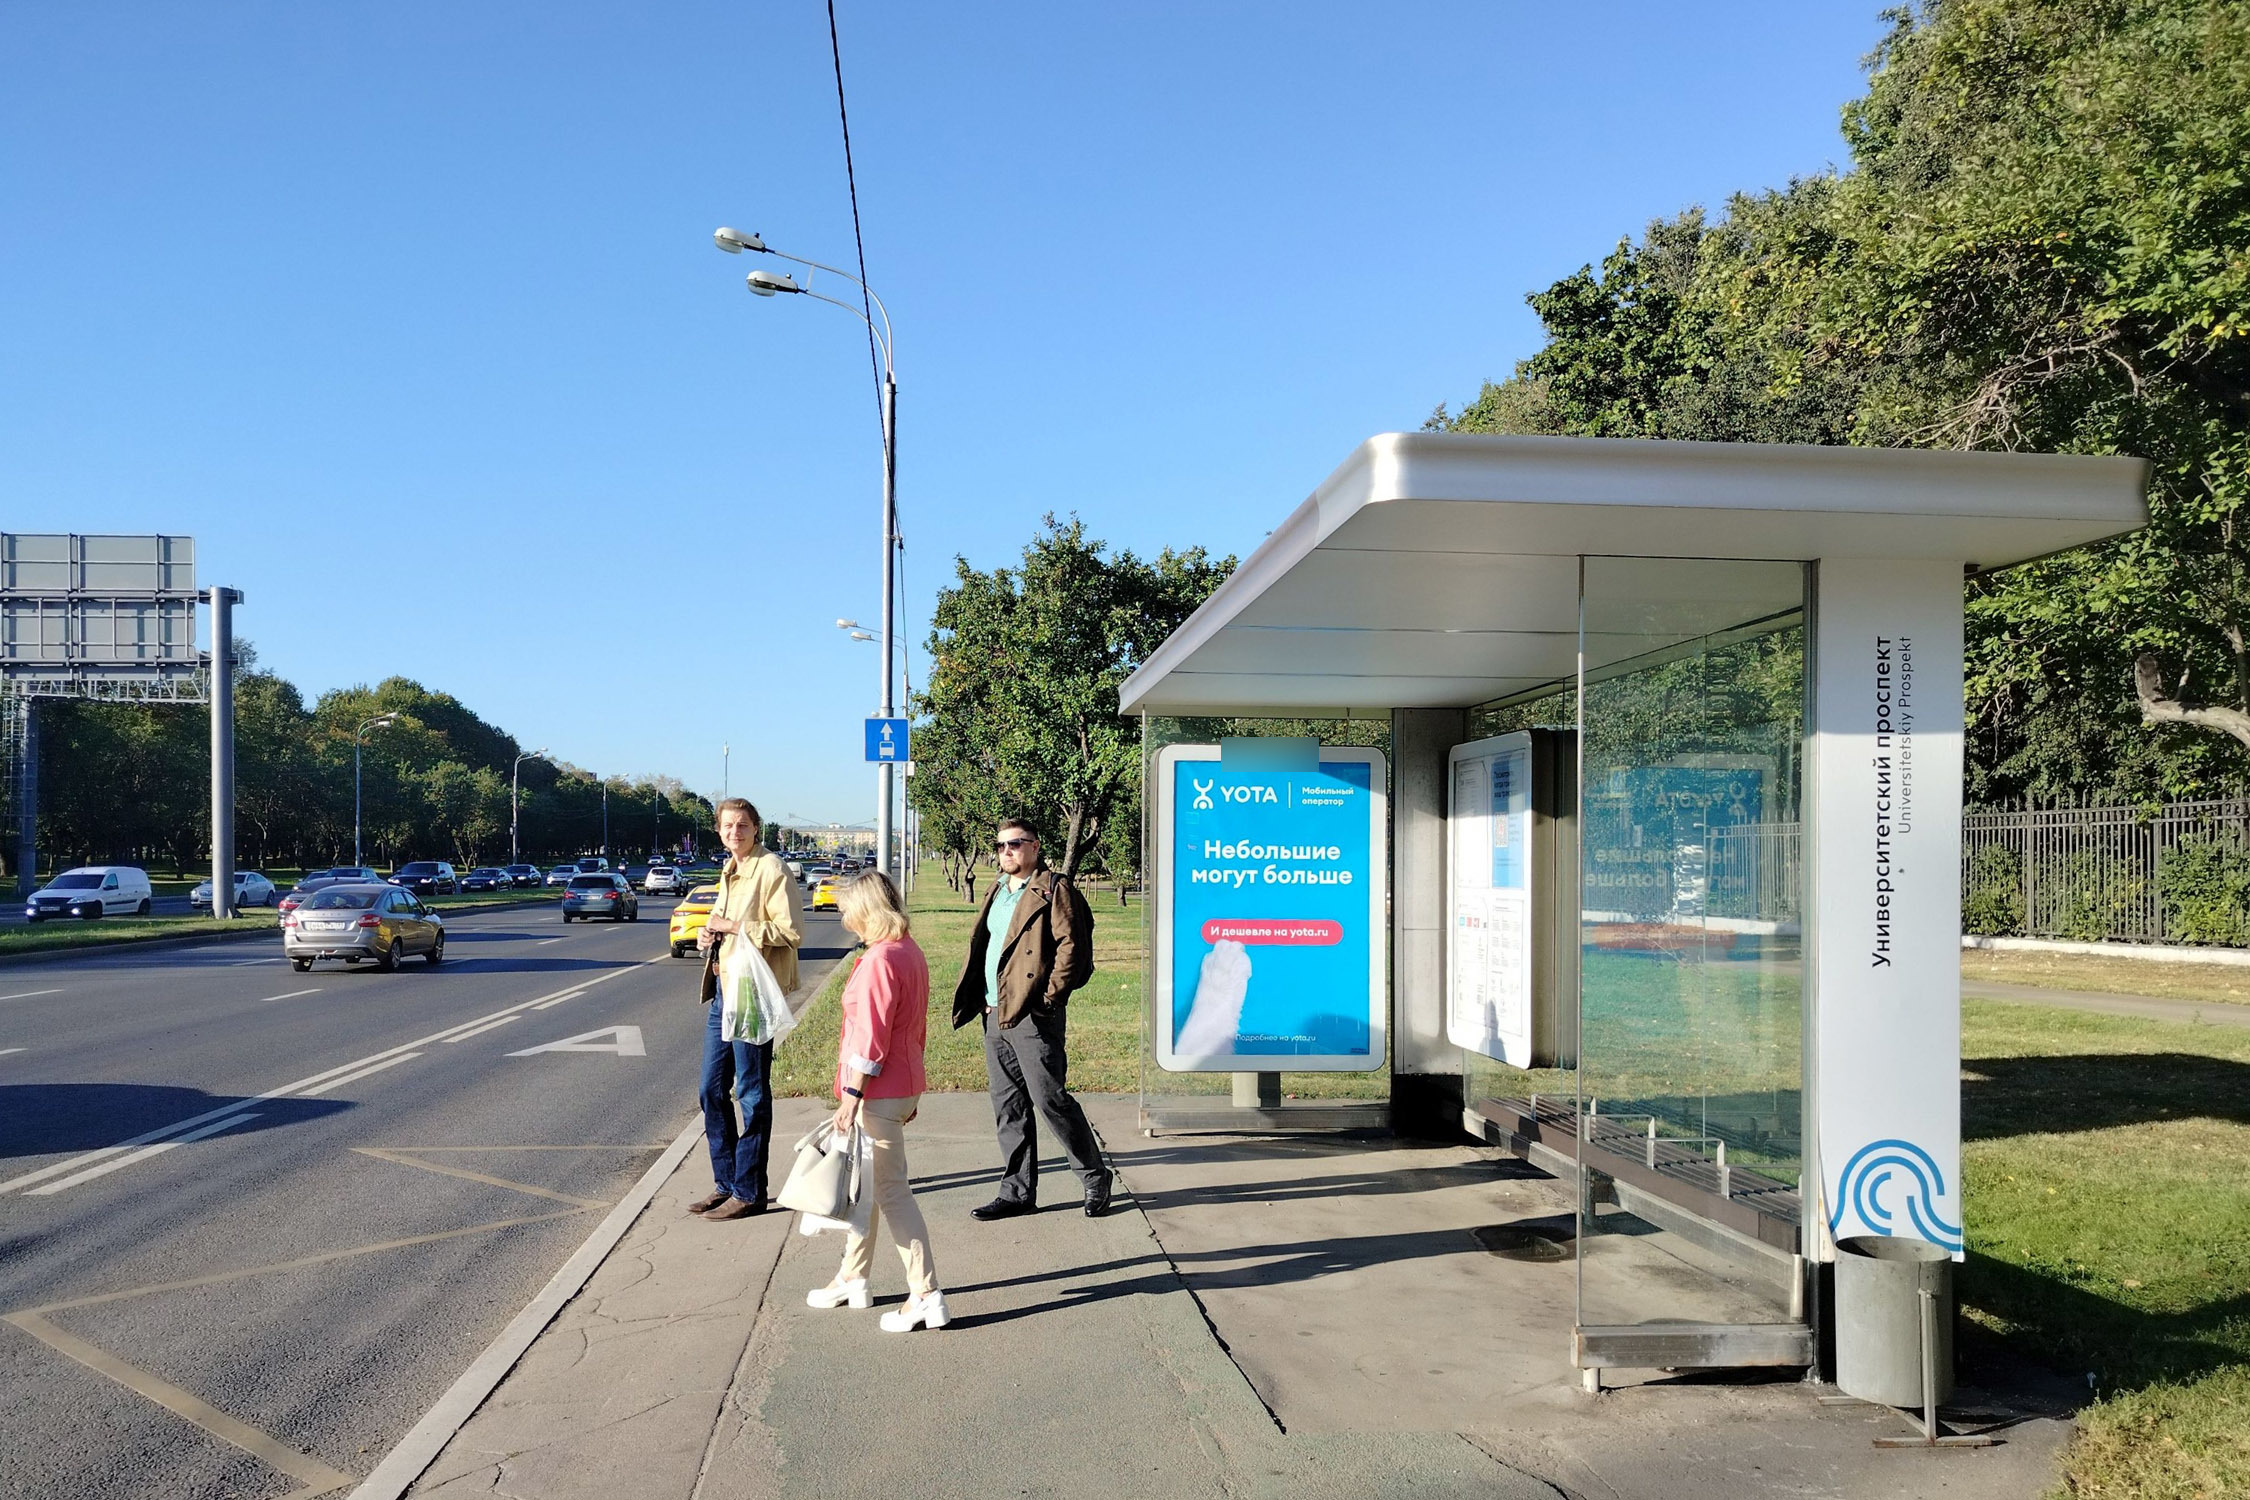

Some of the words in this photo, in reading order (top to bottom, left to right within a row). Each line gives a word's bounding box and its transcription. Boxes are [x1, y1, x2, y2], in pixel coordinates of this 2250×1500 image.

[1898, 636, 1913, 708] Prospekt
[1876, 636, 1894, 748] проспект
[1898, 712, 1913, 834] Universitetskiy
[1220, 785, 1278, 803] YOTA
[1302, 786, 1354, 795] Мобильный
[1302, 798, 1344, 807] оператор
[1204, 839, 1341, 860] Небольшие
[1872, 756, 1894, 968] Университетский
[1191, 868, 1259, 888] могут
[1263, 863, 1353, 885] больше
[1210, 926, 1220, 936] И
[1222, 928, 1272, 937] дешевле
[1274, 928, 1287, 936] на
[1288, 928, 1329, 938] yota.ru
[1235, 1034, 1278, 1042] Подробнее
